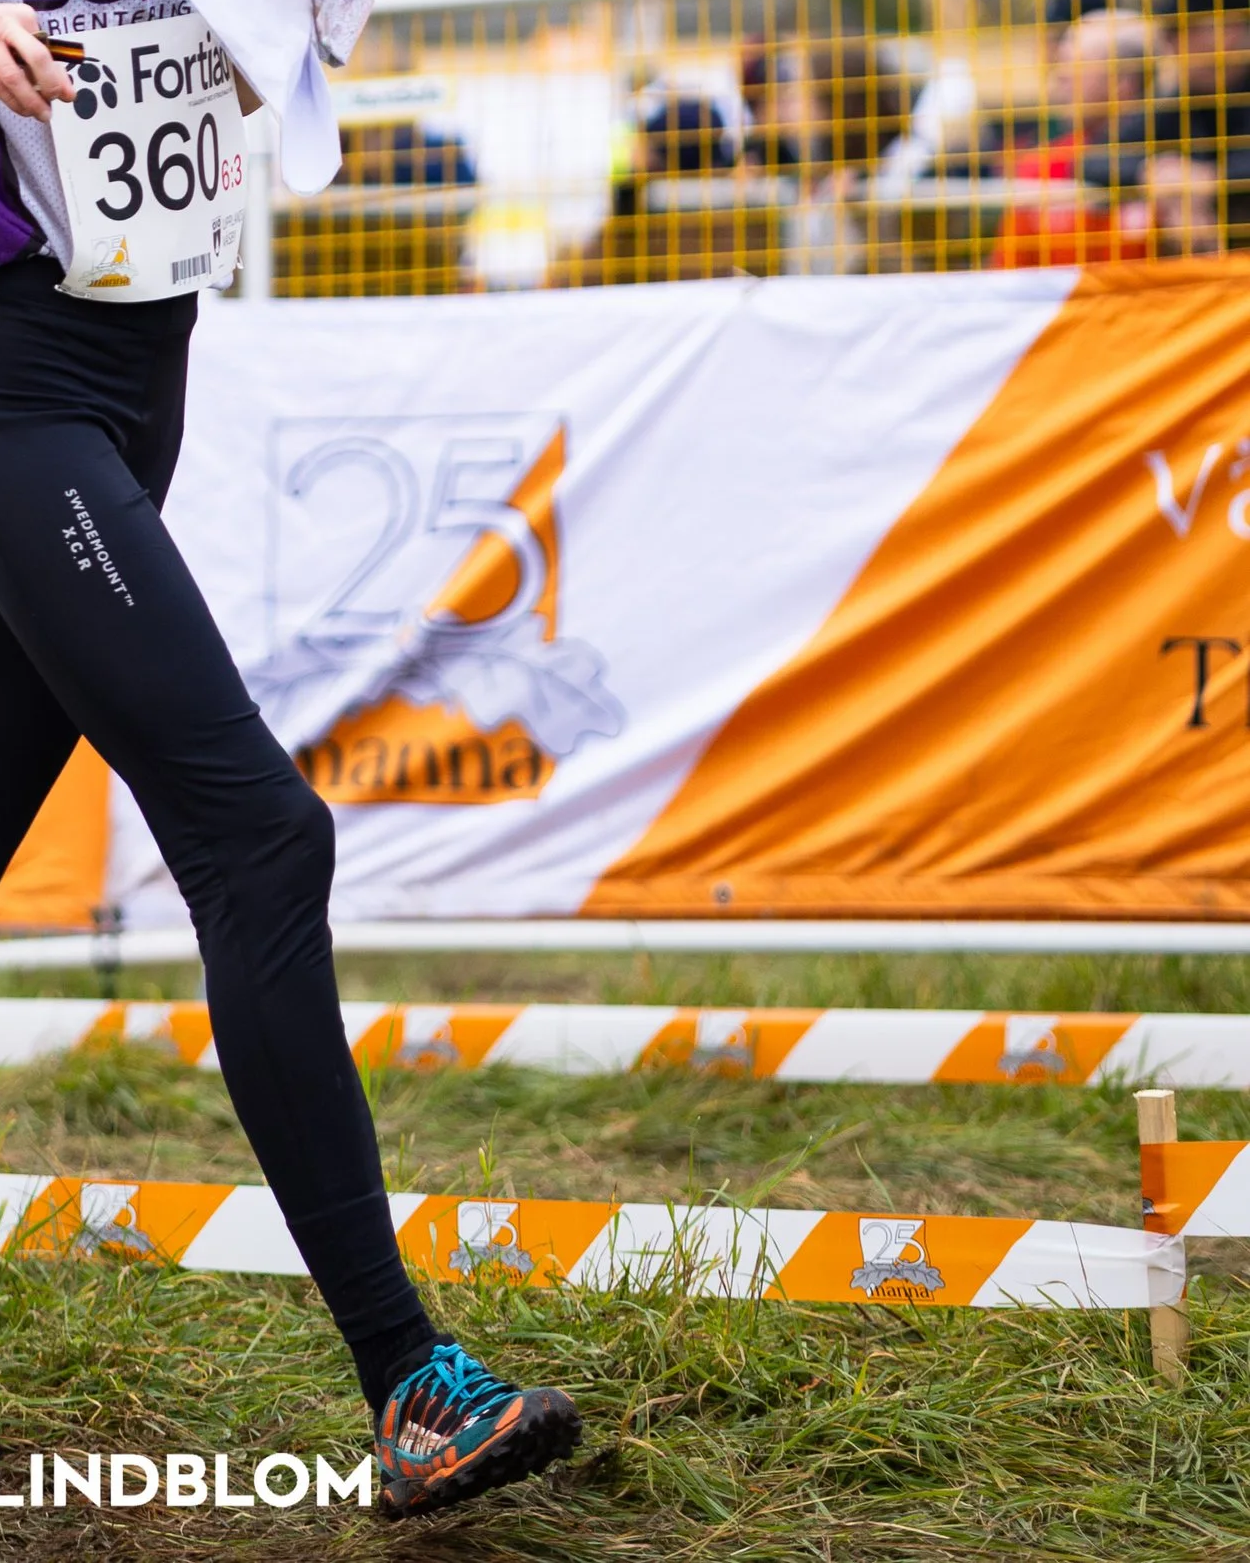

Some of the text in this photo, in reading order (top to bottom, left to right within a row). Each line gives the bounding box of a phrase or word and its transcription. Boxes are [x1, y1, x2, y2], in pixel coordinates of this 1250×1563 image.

[88, 112, 220, 221] 360
[221, 154, 242, 191] 6:3
[285, 434, 548, 646] 25
[461, 1204, 518, 1248] 25
[863, 1222, 926, 1266] 25
